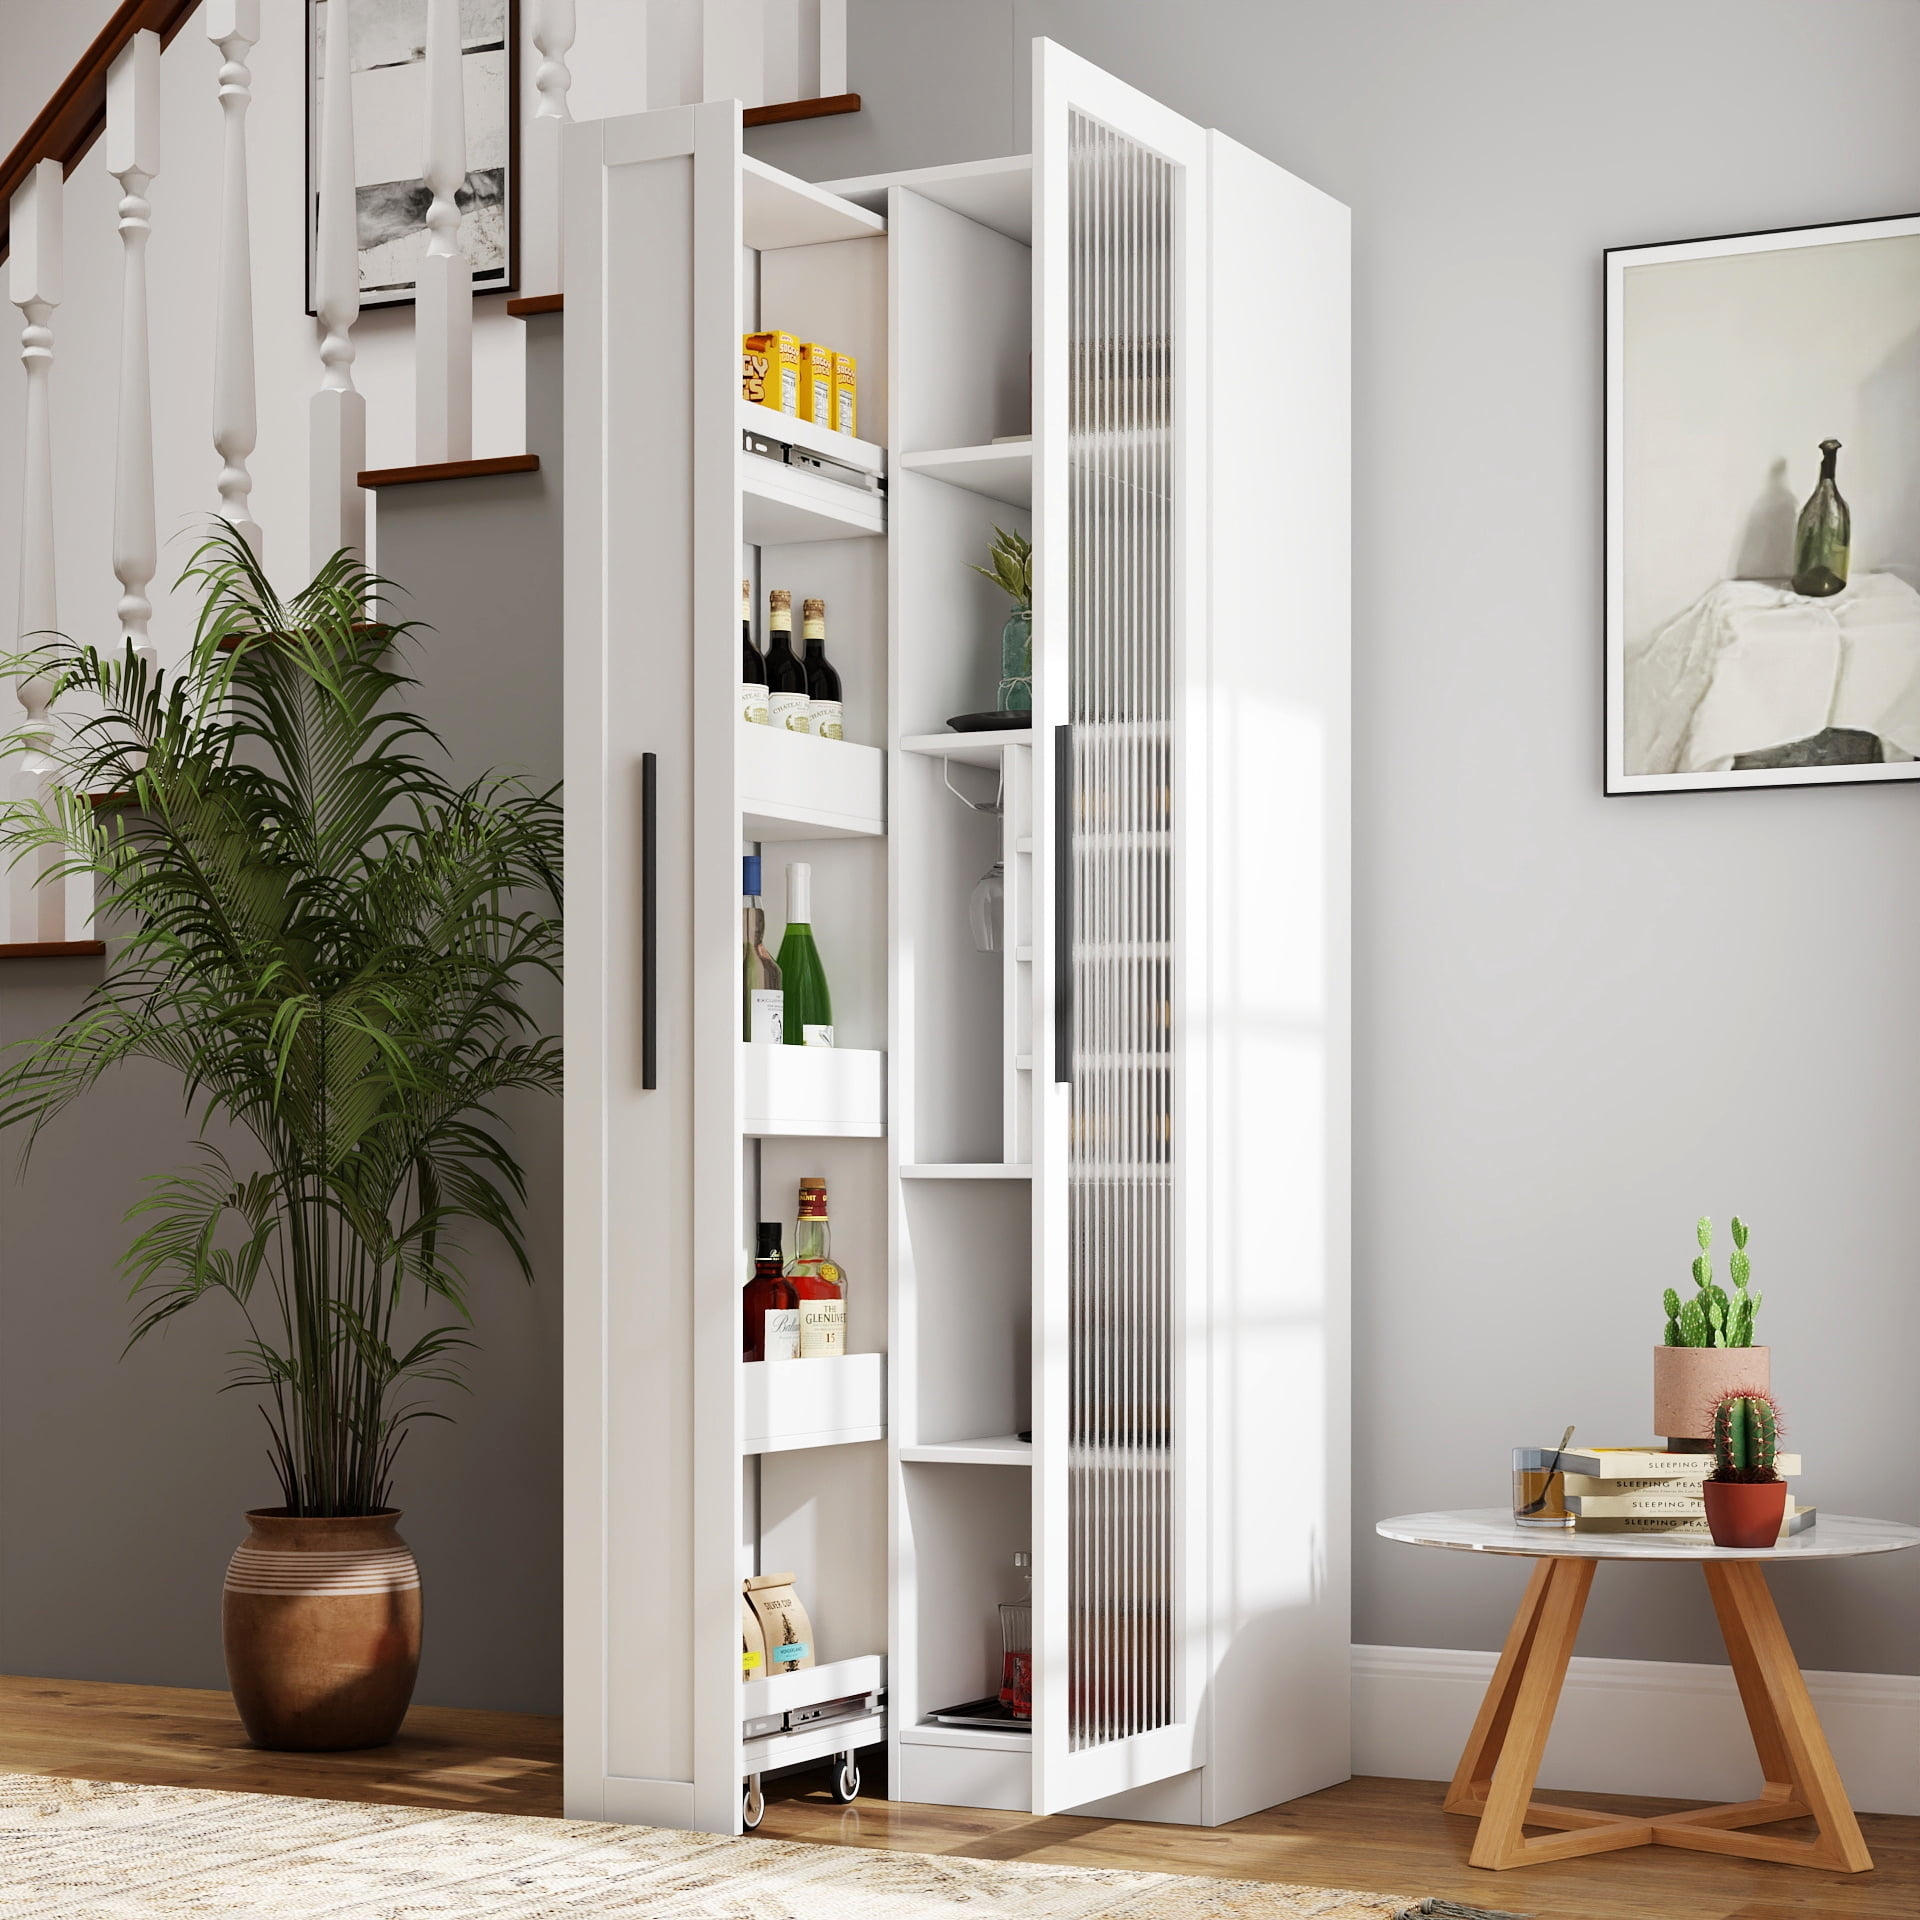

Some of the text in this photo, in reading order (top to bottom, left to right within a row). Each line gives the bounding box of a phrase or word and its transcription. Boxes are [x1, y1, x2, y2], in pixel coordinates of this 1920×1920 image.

[824, 1305, 837, 1313] THE
[805, 1312, 846, 1325] GLENLIVET
[826, 1333, 836, 1343] 15
[1649, 1461, 1698, 1469] SLEEPING
[1616, 1480, 1670, 1488] SLEEPING
[1624, 1518, 1677, 1526] SLEEPING
